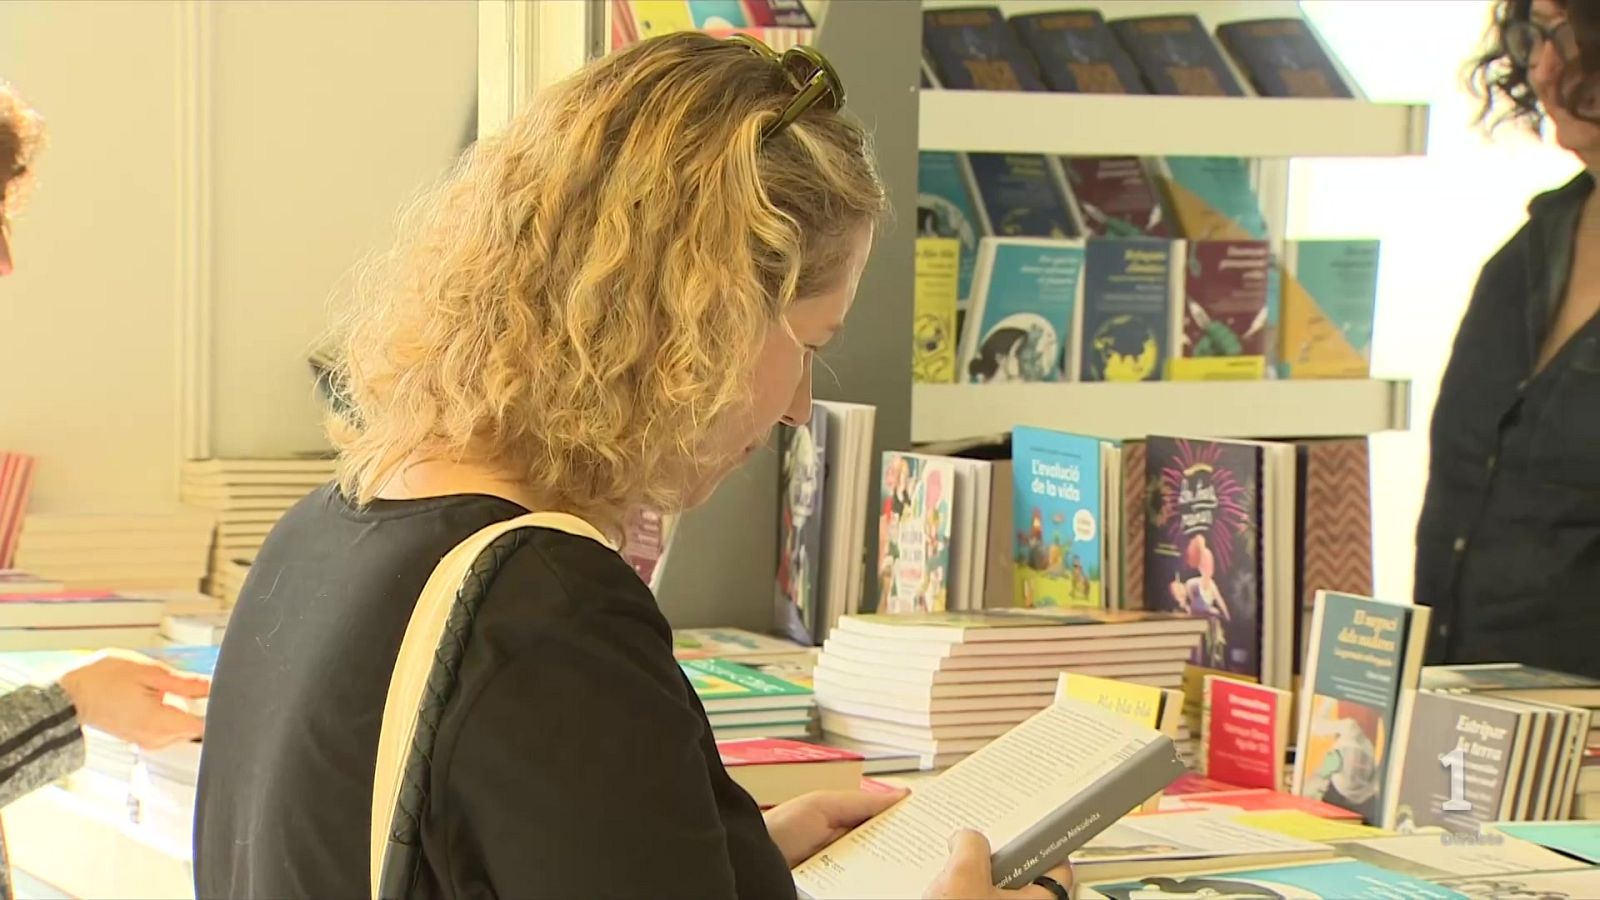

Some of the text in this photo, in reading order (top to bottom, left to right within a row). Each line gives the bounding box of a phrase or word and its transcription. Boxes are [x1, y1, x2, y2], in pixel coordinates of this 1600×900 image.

[1031, 459, 1080, 483] L'evolució
[1031, 477, 1080, 502] de la vida
[1456, 714, 1507, 741] Estripar
[1013, 867, 1022, 878] de
[1023, 855, 1040, 871] zinc
[1040, 836, 1068, 858] Svetlana
